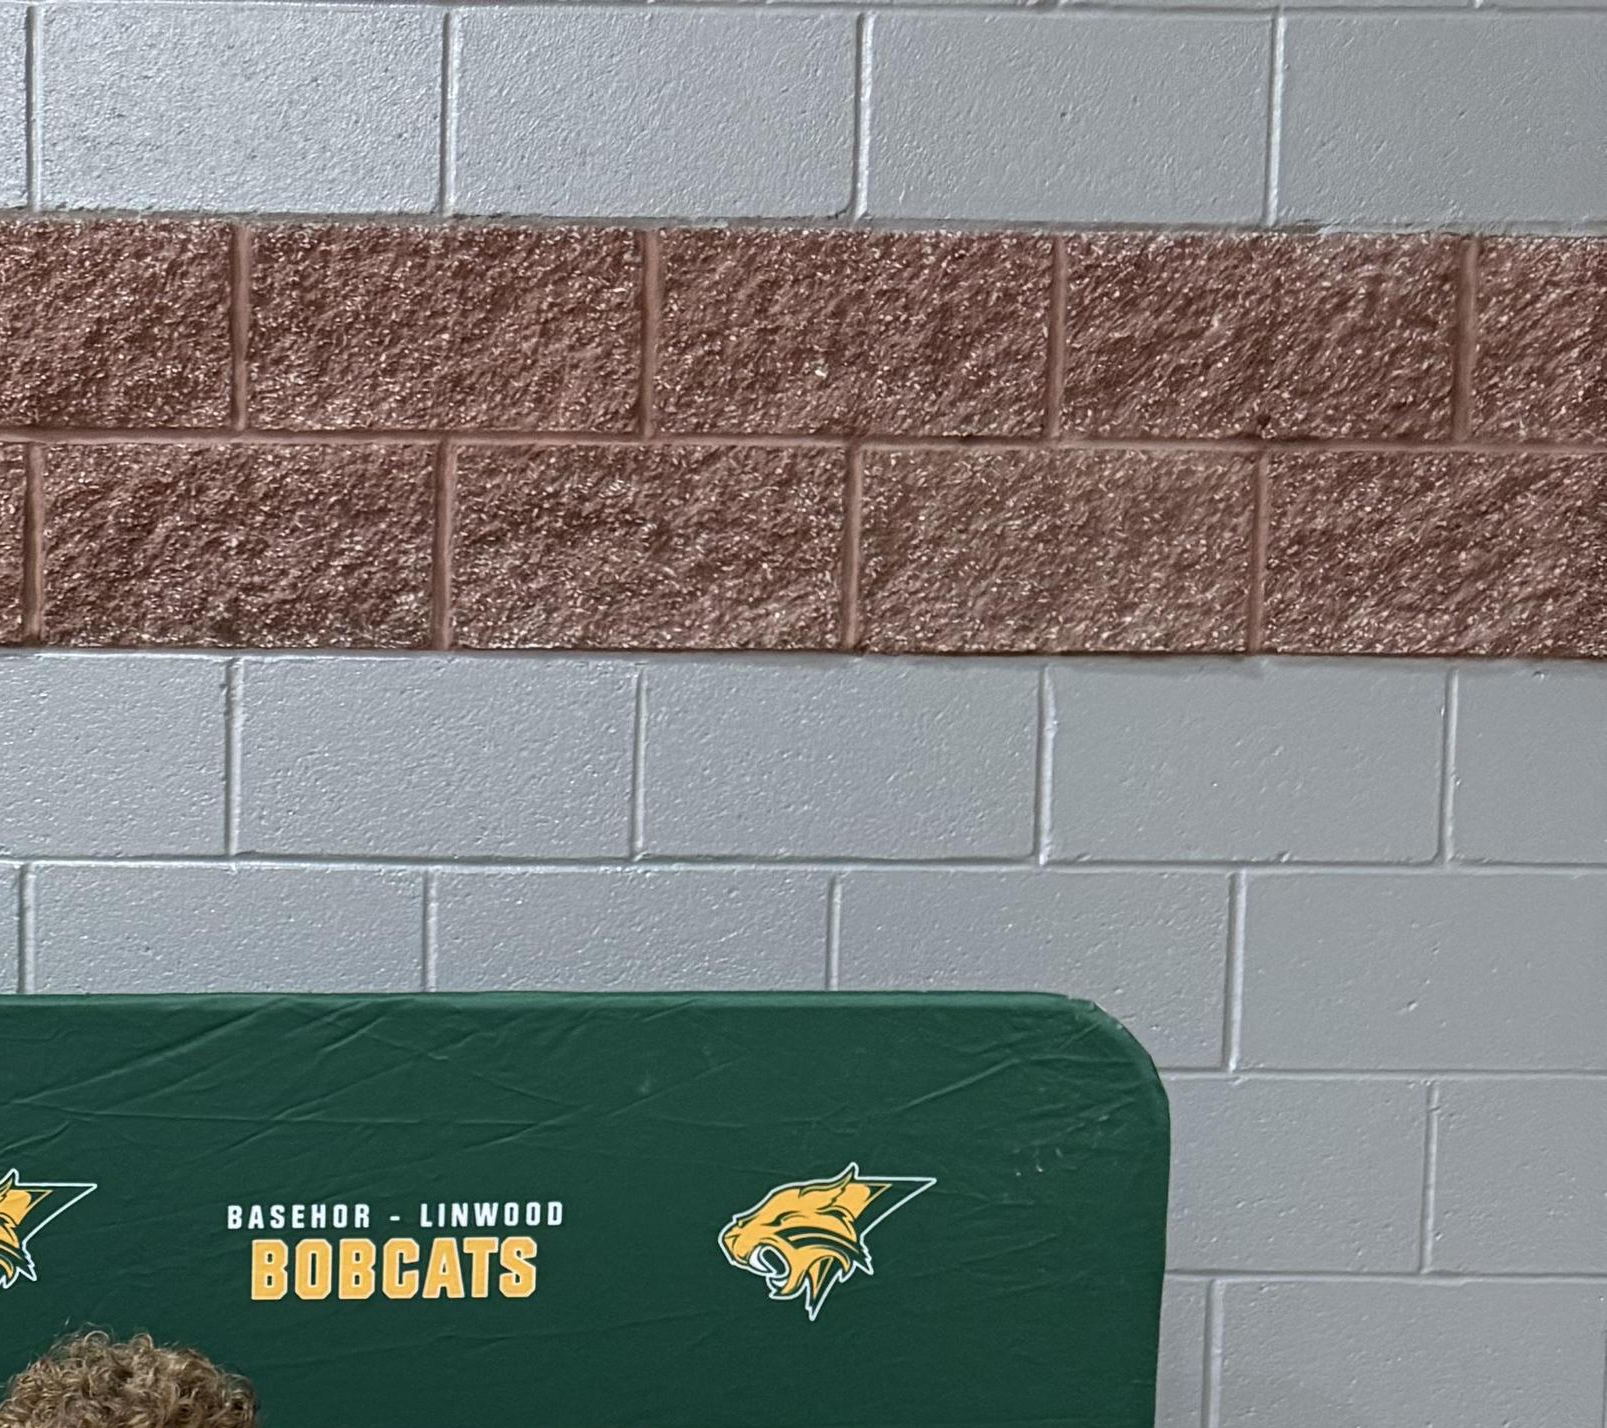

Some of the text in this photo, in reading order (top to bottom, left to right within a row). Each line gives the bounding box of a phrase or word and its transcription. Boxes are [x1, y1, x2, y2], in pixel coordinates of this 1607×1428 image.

[227, 1203, 371, 1230] BASEHOR
[420, 1201, 564, 1228] LINWOOD
[250, 1235, 539, 1301] BOBCATS
